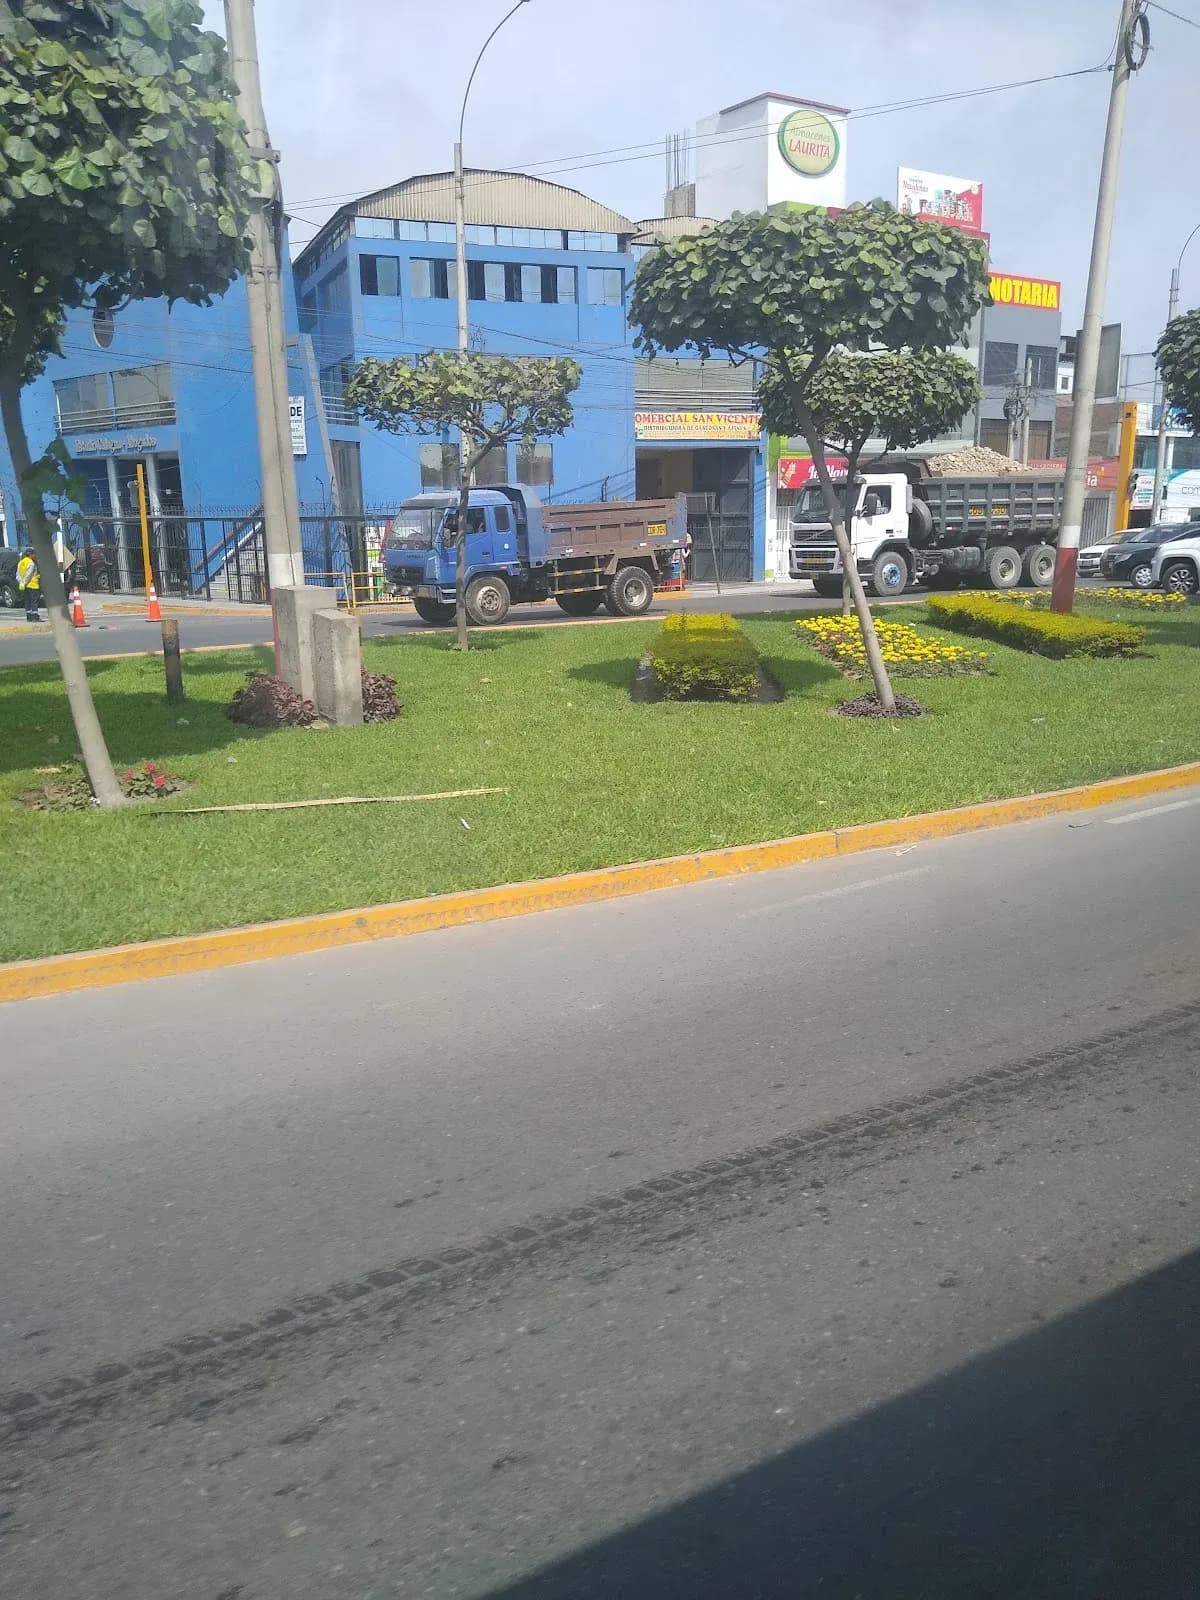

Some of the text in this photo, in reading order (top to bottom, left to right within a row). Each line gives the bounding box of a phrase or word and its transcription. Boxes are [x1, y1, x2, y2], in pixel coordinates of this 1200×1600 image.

[789, 138, 830, 159] LAURITA
[989, 276, 1058, 309] NOTARIA
[290, 406, 302, 417] DE
[692, 414, 713, 423] SAN
